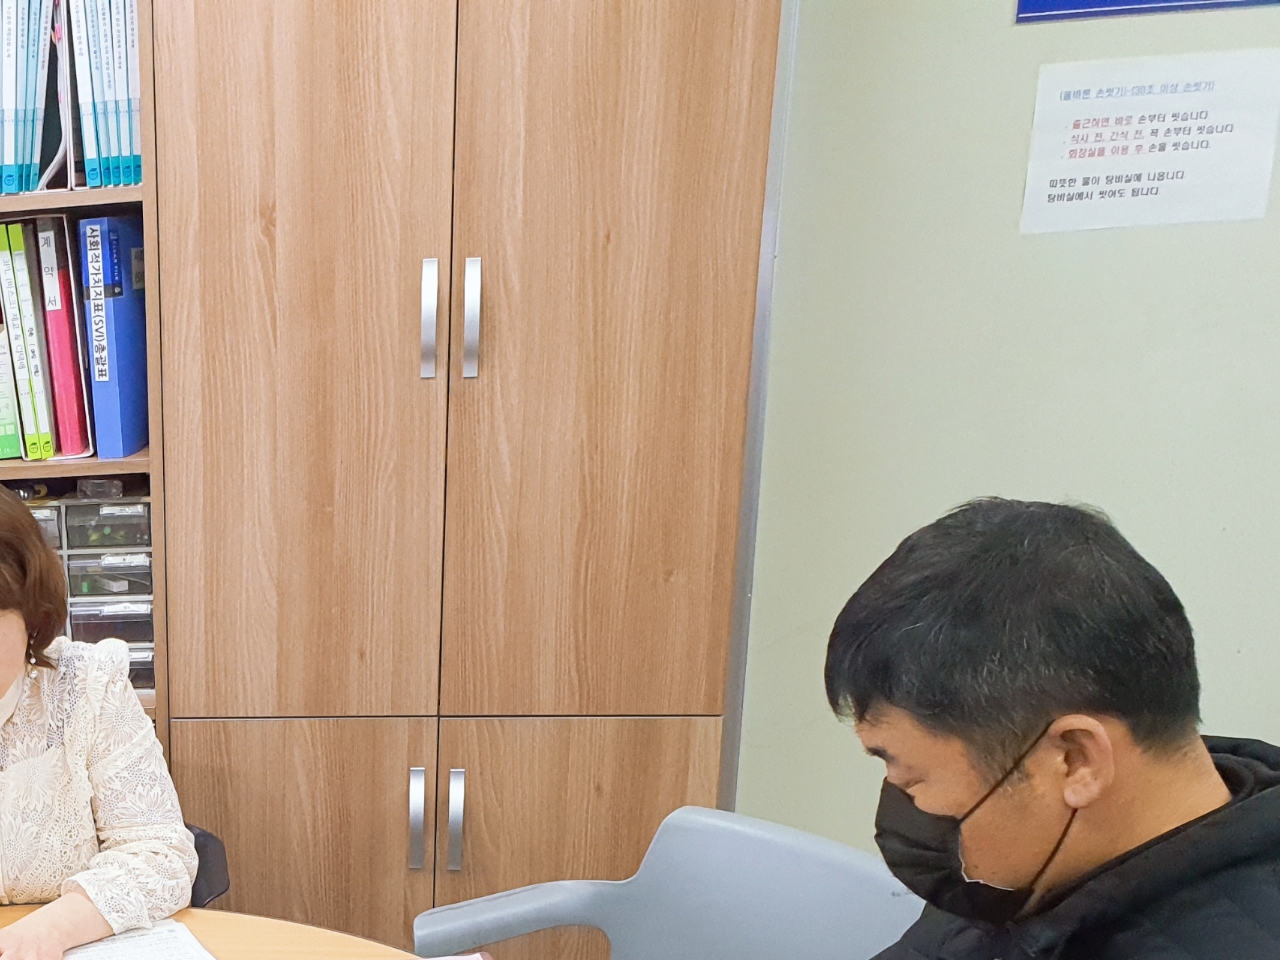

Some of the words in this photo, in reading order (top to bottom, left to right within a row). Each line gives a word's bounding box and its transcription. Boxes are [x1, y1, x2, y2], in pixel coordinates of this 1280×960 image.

[1138, 113, 1166, 125] 손부터
[1071, 133, 1089, 144] 식사
[1110, 130, 1129, 142] 간식
[1164, 126, 1192, 138] 손부터
[1049, 177, 1077, 189] 따뜻한
[1082, 175, 1100, 187] 물이
[1098, 188, 1126, 200] 씻어도
[87, 226, 108, 379] 사회적가치지표(SVI)총괄표
